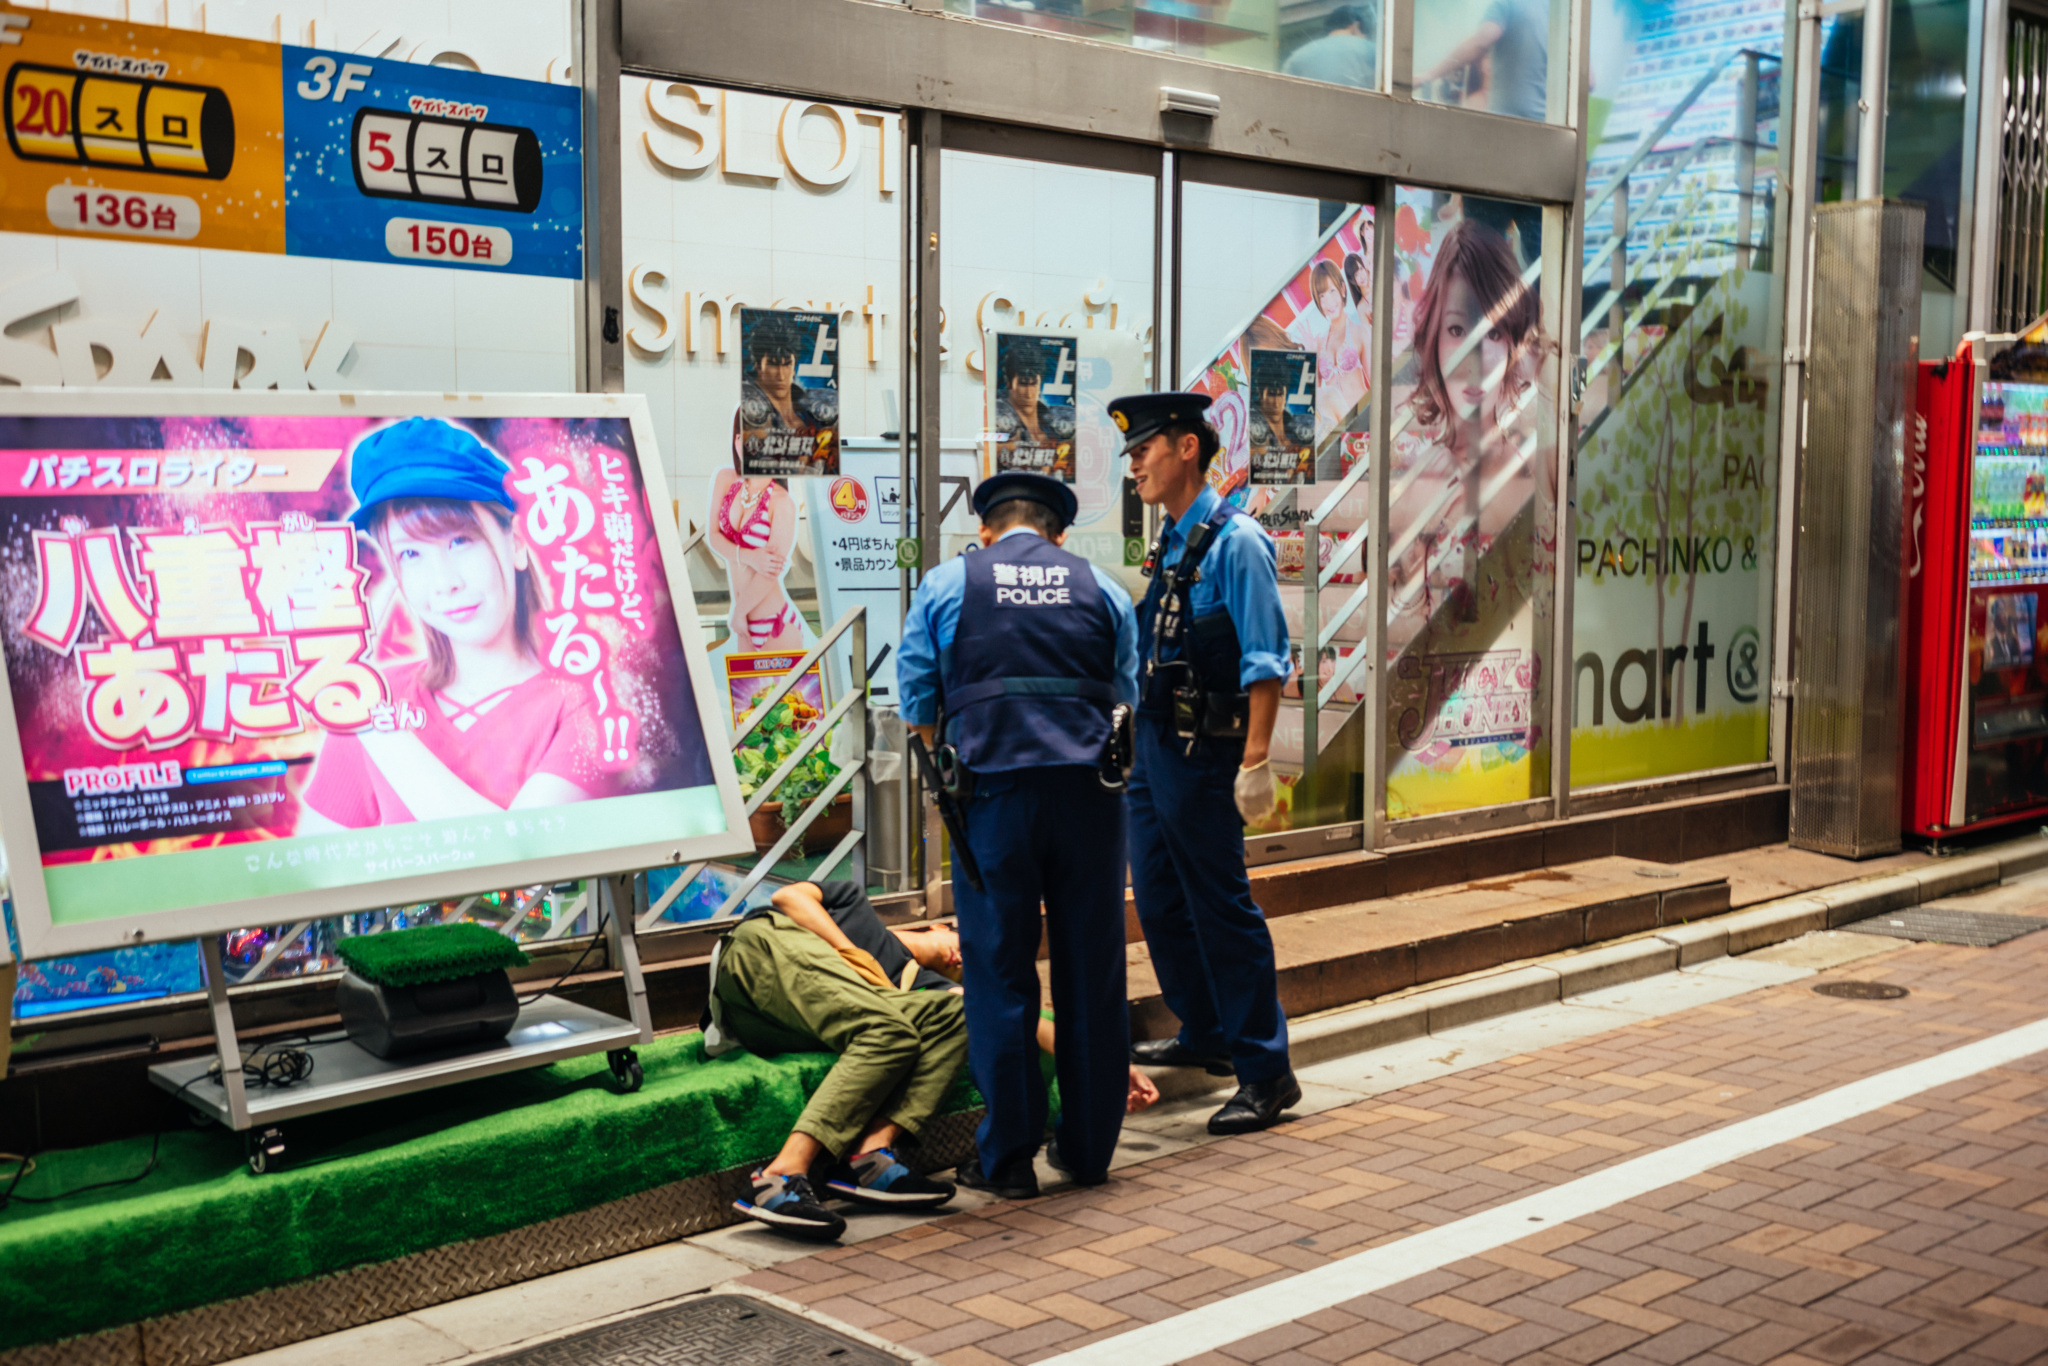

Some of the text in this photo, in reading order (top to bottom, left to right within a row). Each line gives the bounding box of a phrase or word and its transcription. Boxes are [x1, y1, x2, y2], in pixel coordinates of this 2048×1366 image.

[297, 56, 373, 102] 3F
[73, 193, 177, 231] 136台
[407, 225, 493, 259] 150台
[21, 455, 287, 488] パチスロライター
[599, 453, 645, 631] ヒキ弱だけど、
[1577, 535, 1758, 578] PACHINKO &
[993, 563, 1070, 586] 警視庁
[996, 587, 1071, 605] POLICE
[80, 630, 388, 744] あたる
[64, 760, 183, 798] PROFILE
